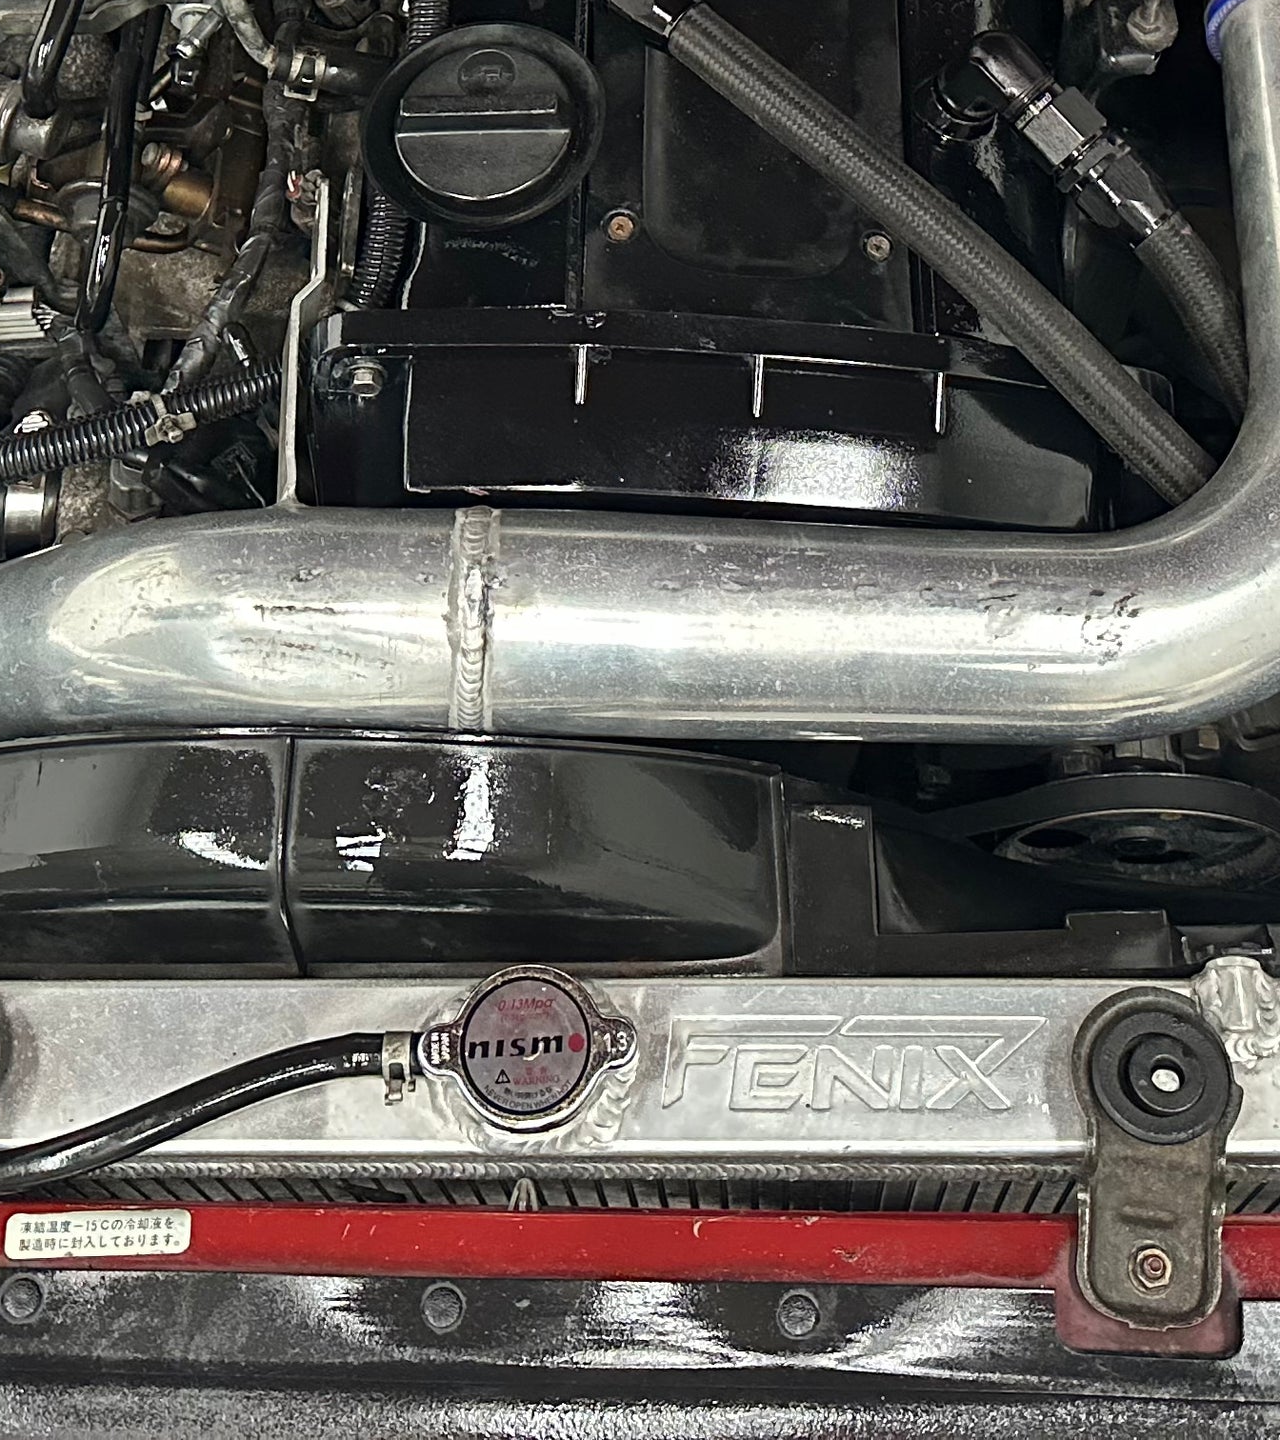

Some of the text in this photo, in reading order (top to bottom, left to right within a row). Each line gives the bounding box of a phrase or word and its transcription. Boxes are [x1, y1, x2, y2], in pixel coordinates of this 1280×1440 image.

[662, 1014, 1048, 1111] FENIX
[513, 1074, 560, 1086] WARNING
[484, 1084, 508, 1107] NEVER
[510, 1101, 533, 1110] OPEN
[534, 1094, 559, 1109] WHEN
